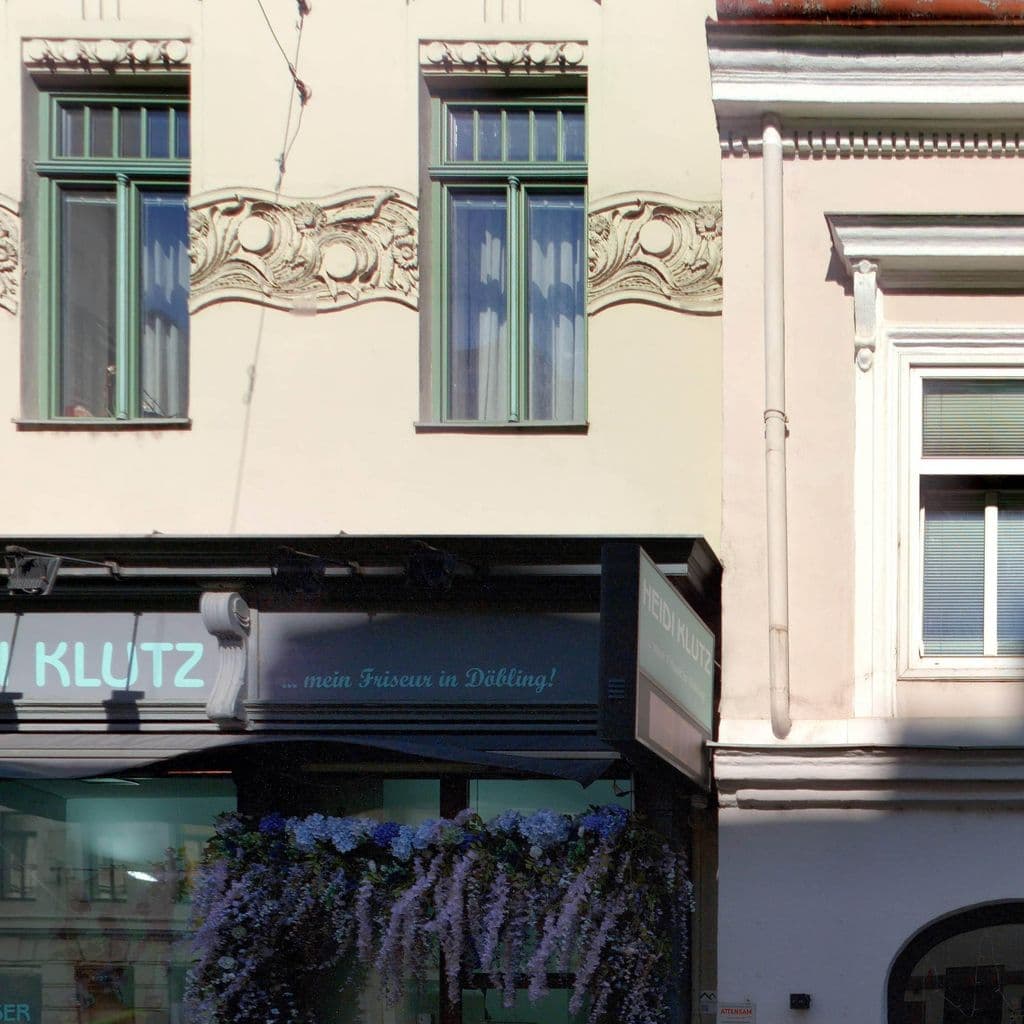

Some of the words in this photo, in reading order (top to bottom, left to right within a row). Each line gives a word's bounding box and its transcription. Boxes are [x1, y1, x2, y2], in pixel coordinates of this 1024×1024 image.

[642, 578, 675, 638] HEIDI
[676, 617, 712, 676] KLUTZ
[35, 641, 205, 689] KLUTZ
[303, 670, 353, 689] mein
[359, 667, 433, 689] Friseur
[438, 670, 460, 689] in
[464, 667, 559, 693] Döbling!
